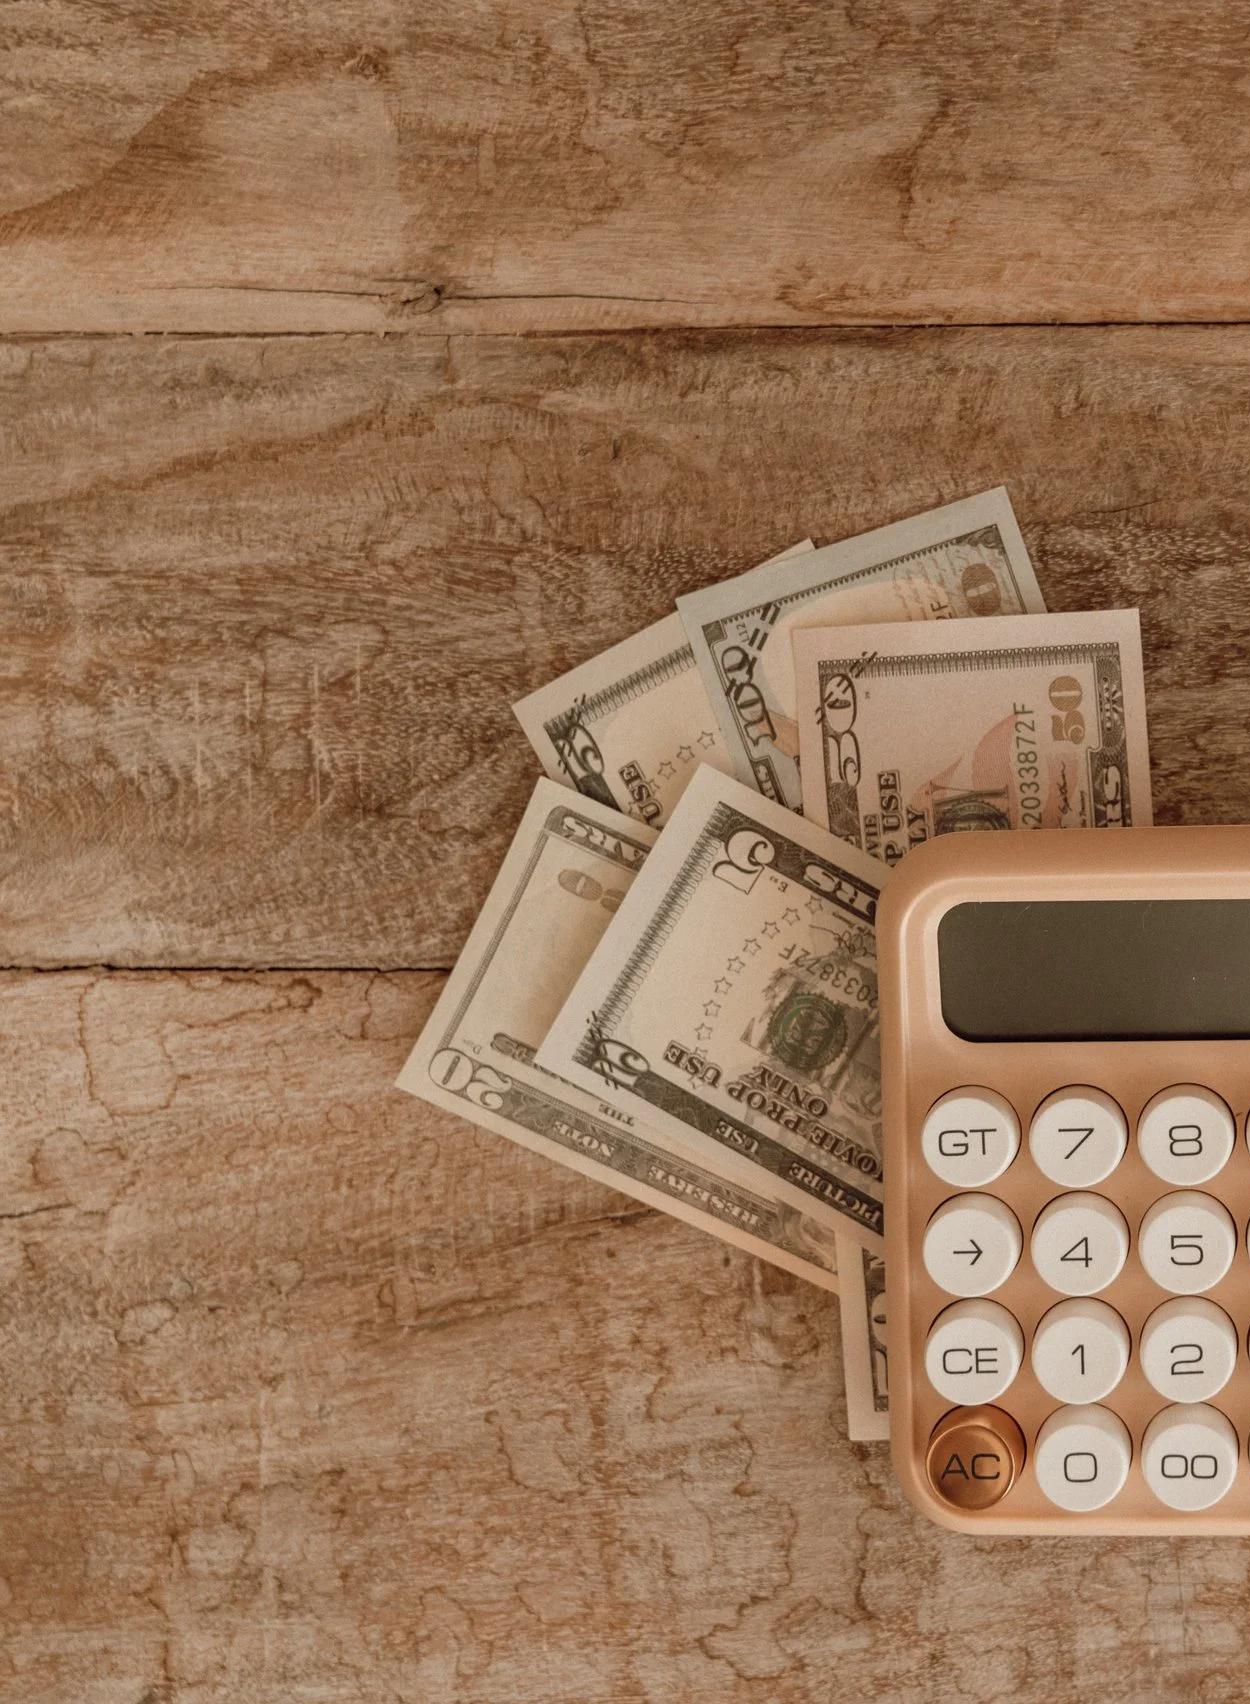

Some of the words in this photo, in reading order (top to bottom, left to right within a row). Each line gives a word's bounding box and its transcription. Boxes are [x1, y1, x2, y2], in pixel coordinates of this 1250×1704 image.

[824, 673, 861, 787] 50
[1048, 674, 1086, 745] 50
[1012, 701, 1042, 829] 2033872F
[617, 762, 661, 826] USE
[878, 770, 901, 833] USE
[863, 814, 879, 860] VIE
[906, 806, 926, 844] LY
[713, 824, 776, 896] 5
[427, 1044, 513, 1111] 20
[661, 1042, 725, 1087] USE
[724, 1078, 806, 1133] PROP
[750, 1063, 832, 1119] ONLY
[596, 1101, 637, 1127] THE
[549, 1117, 617, 1158] NOTE
[714, 1120, 761, 1153] USE
[806, 1122, 883, 1178] OVIE
[939, 1128, 997, 1157] GT
[1057, 1127, 1095, 1160] 7
[1168, 1124, 1203, 1157] 8
[645, 1163, 762, 1227] RESERVE
[786, 1161, 882, 1223] PICTURE
[1060, 1236, 1093, 1268] 4
[1170, 1234, 1204, 1266] 5
[942, 1348, 999, 1375] CE
[1071, 1344, 1085, 1376] 1
[1170, 1343, 1205, 1376] 2
[940, 1451, 1001, 1482] AC
[1160, 1453, 1219, 1480] 00
